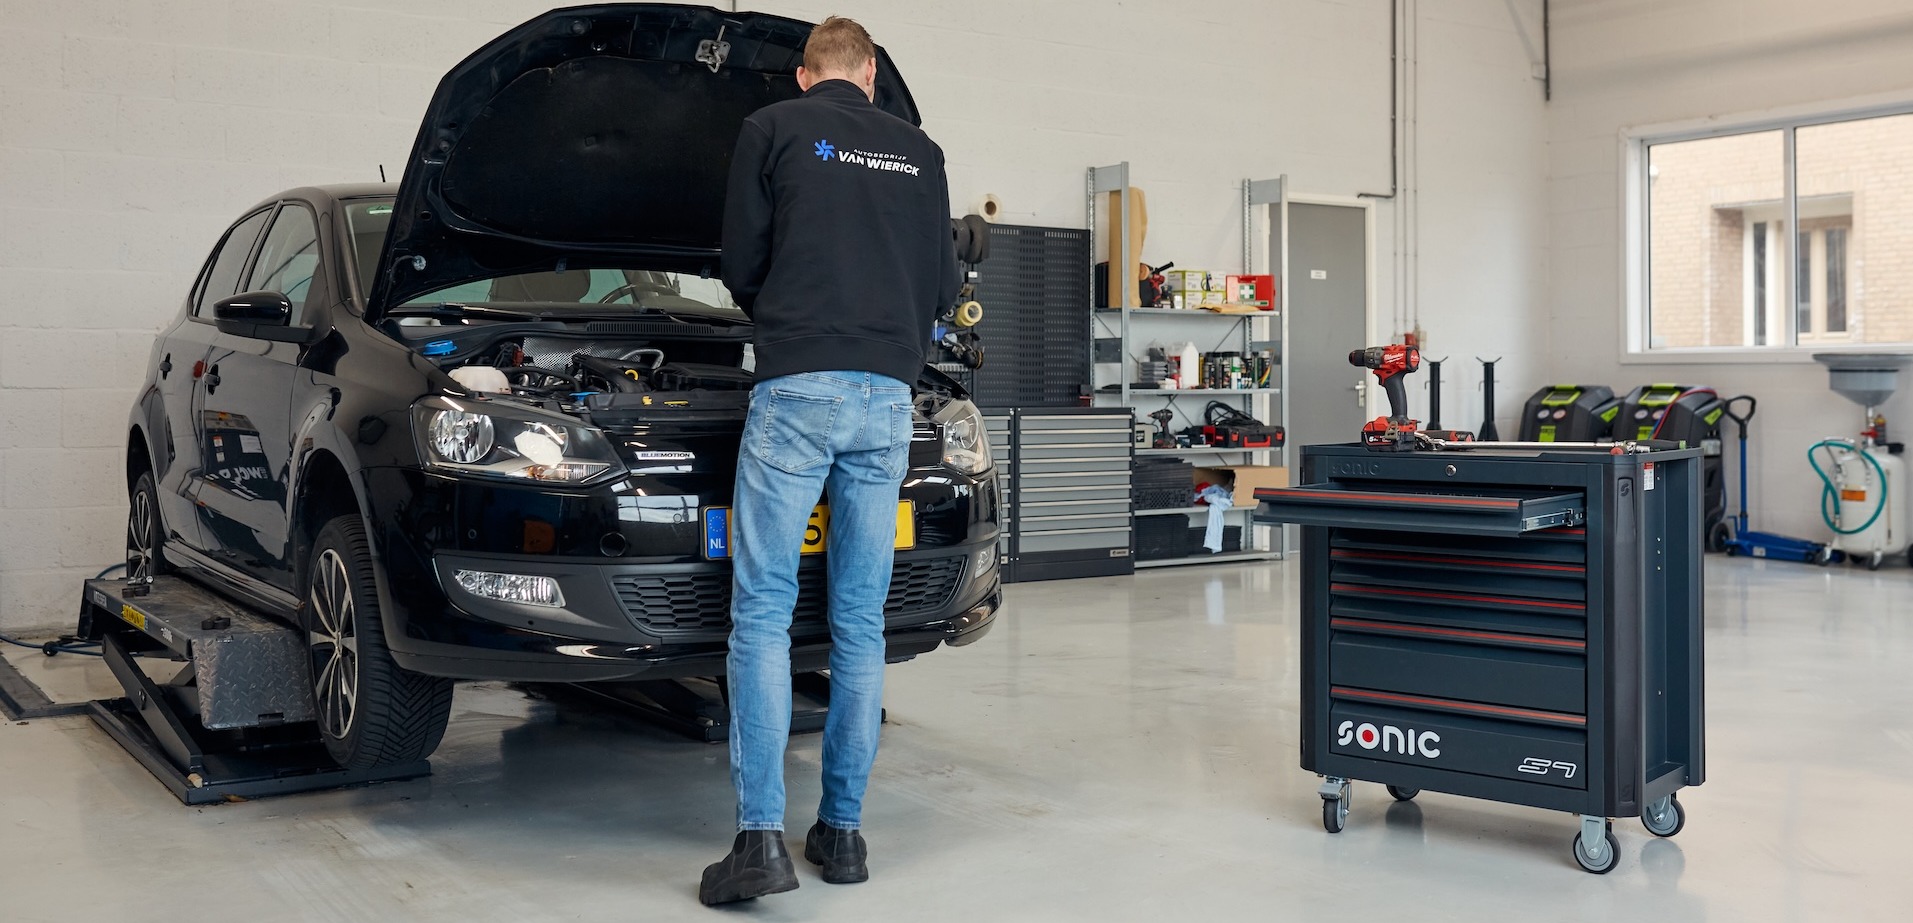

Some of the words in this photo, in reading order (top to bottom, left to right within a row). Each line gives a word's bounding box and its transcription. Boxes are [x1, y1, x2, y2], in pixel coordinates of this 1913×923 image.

[838, 150, 865, 166] VAN
[866, 158, 920, 177] WIERICK
[853, 148, 907, 161] AUTOBEDRIJF
[710, 538, 725, 549] NL
[1338, 720, 1441, 759] SONIC
